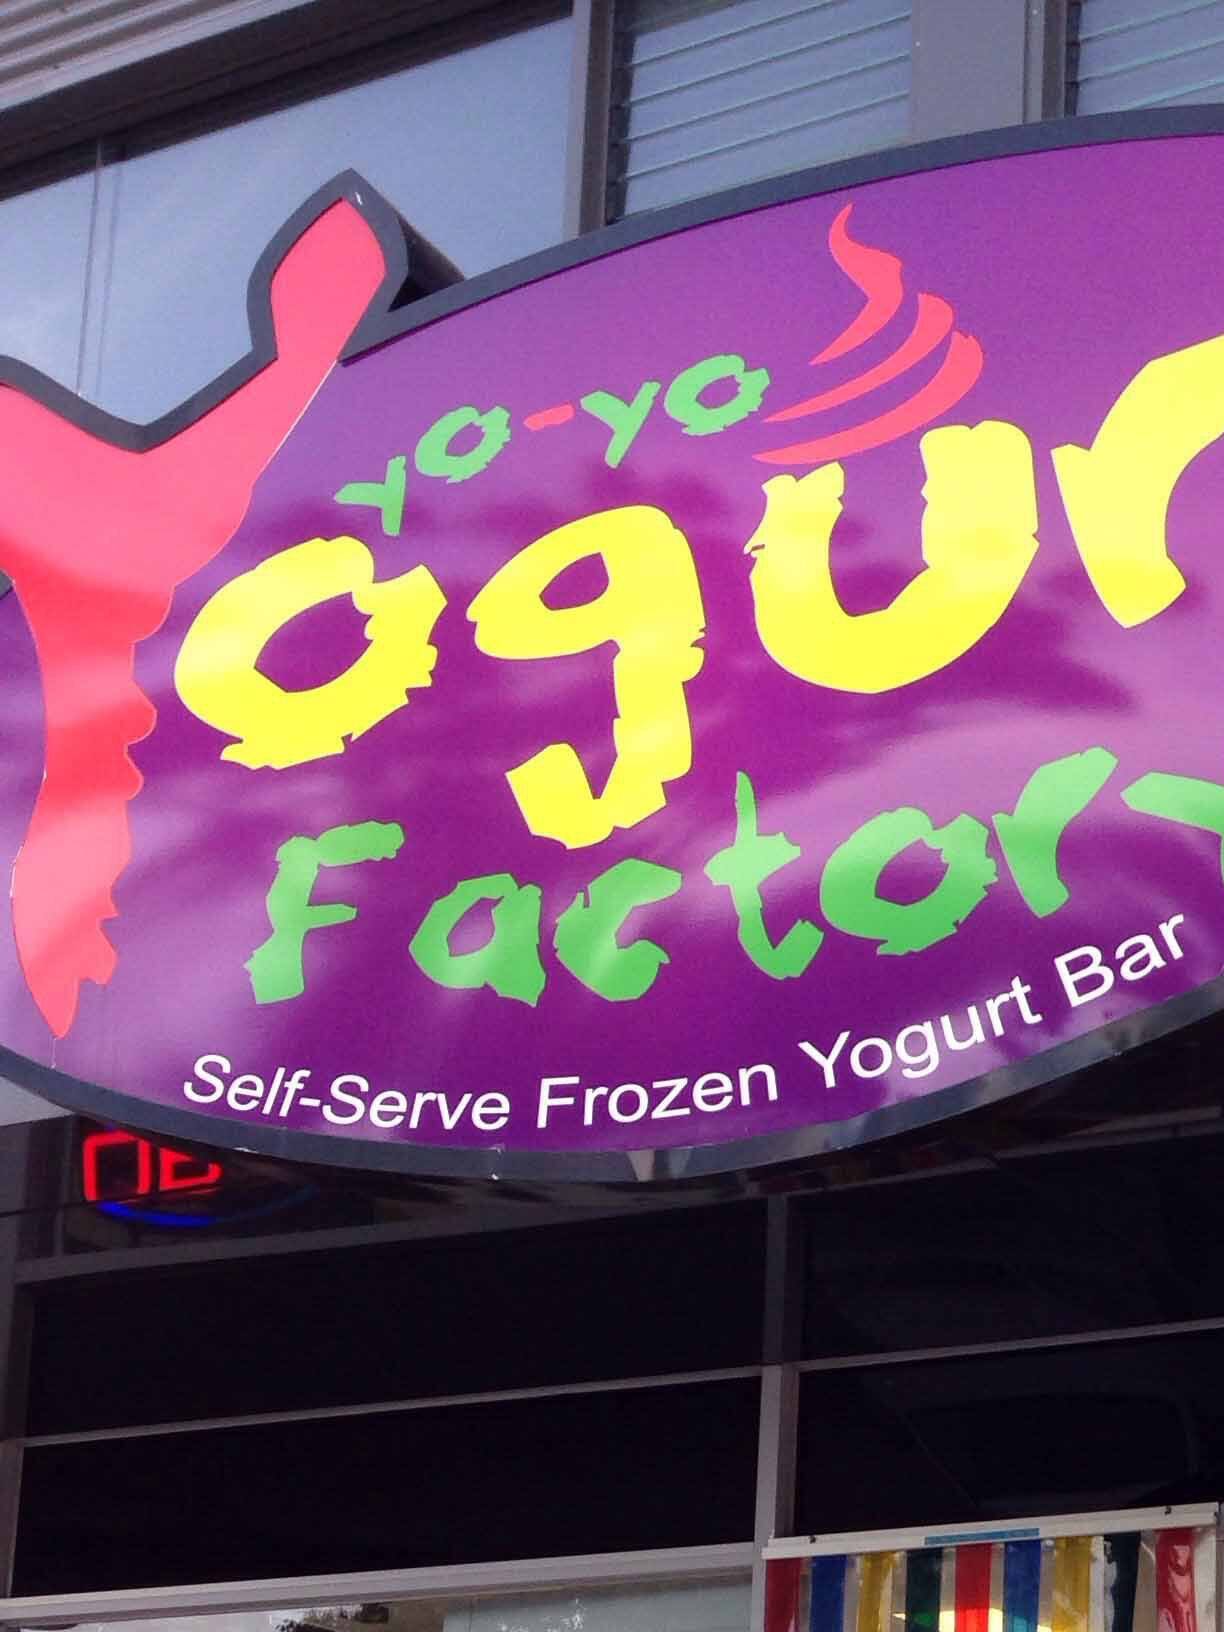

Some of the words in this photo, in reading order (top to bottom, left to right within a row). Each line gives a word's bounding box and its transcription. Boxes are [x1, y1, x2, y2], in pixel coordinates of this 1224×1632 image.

[182, 1053, 512, 1132] Self-Serve
[535, 1063, 779, 1130] Frozen
[798, 975, 1043, 1089] Yogurt
[1054, 913, 1185, 1008] Bar
